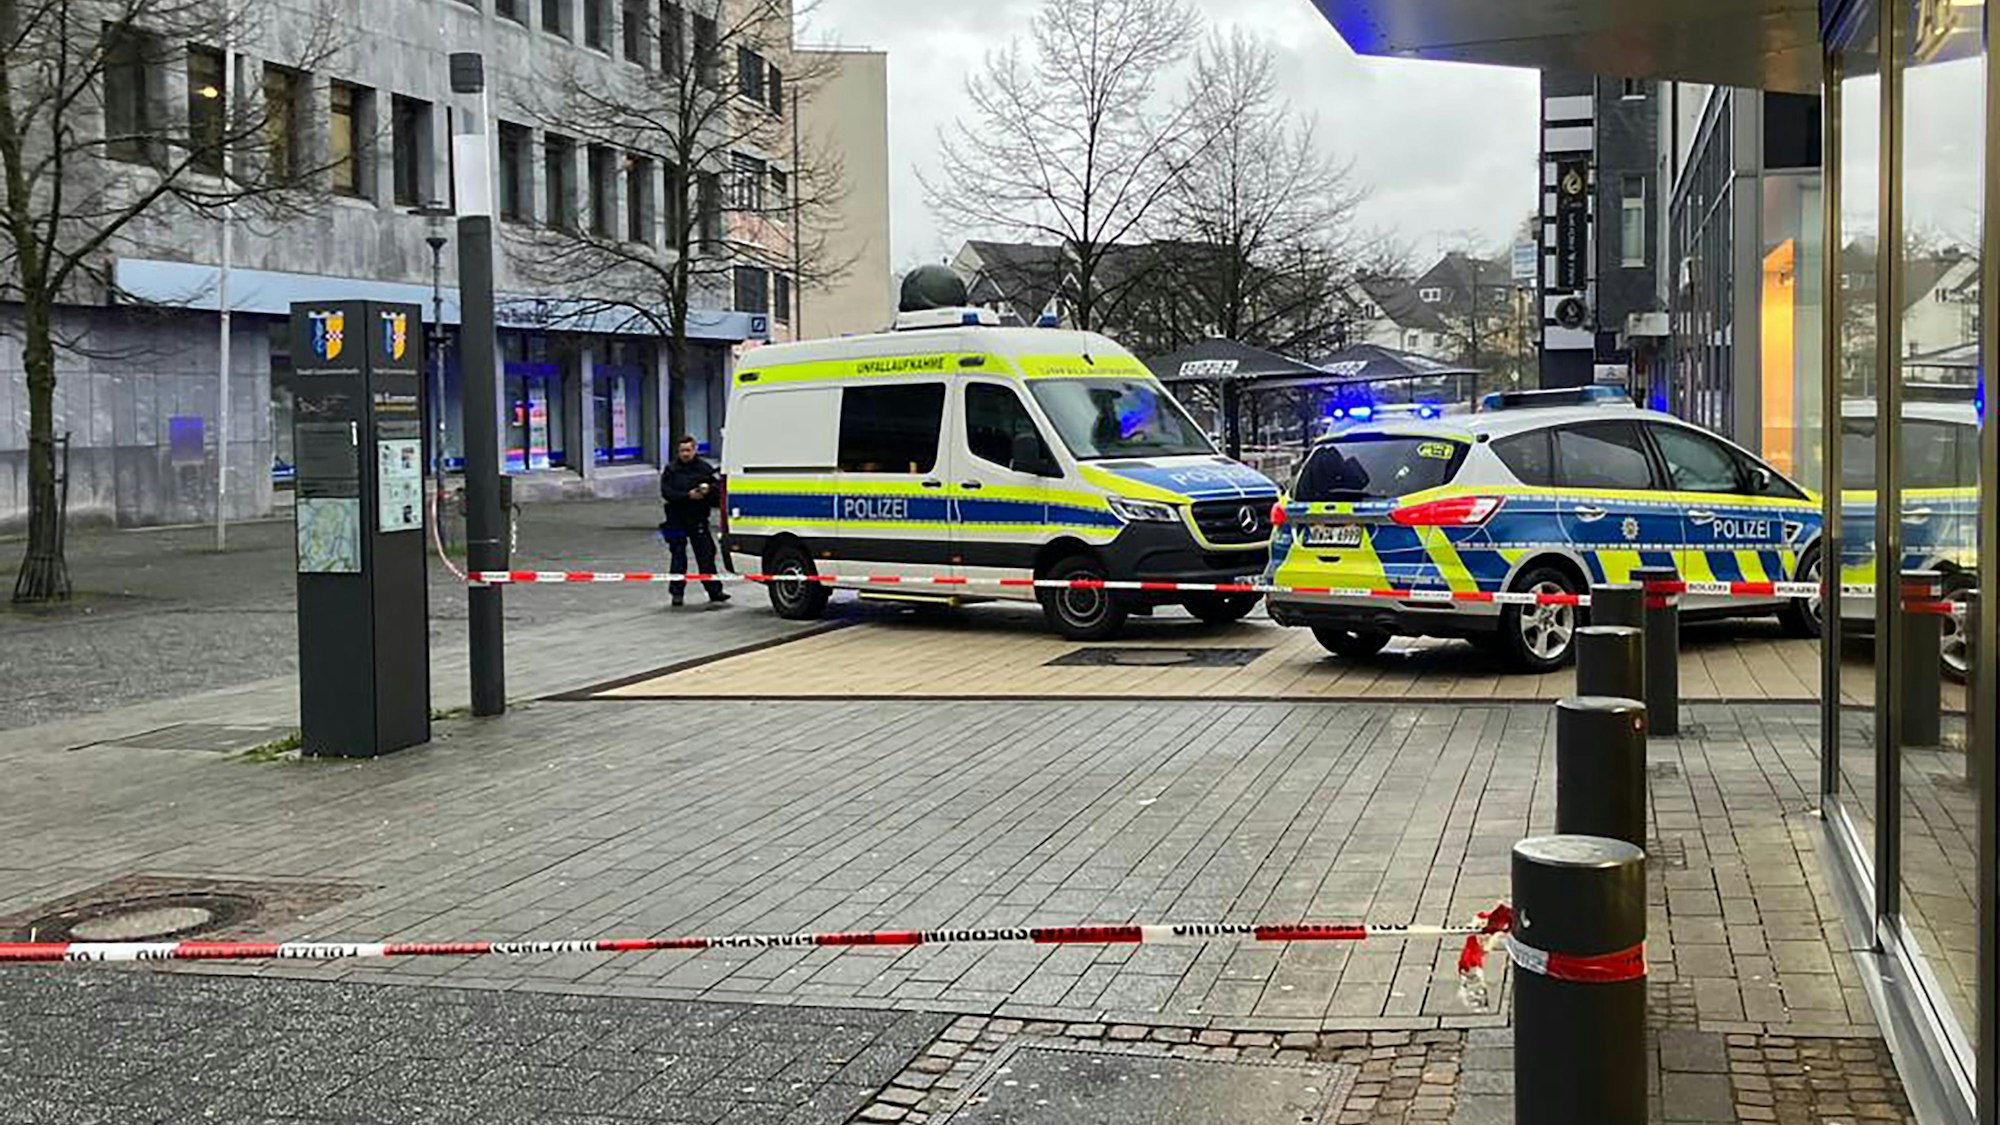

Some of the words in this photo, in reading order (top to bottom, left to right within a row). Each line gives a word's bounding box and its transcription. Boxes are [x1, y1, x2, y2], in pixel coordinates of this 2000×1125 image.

[856, 357, 944, 374] UNFALLAUFNAHME
[844, 498, 908, 518] POLIZEI
[1712, 519, 1771, 539] POLIZEI
